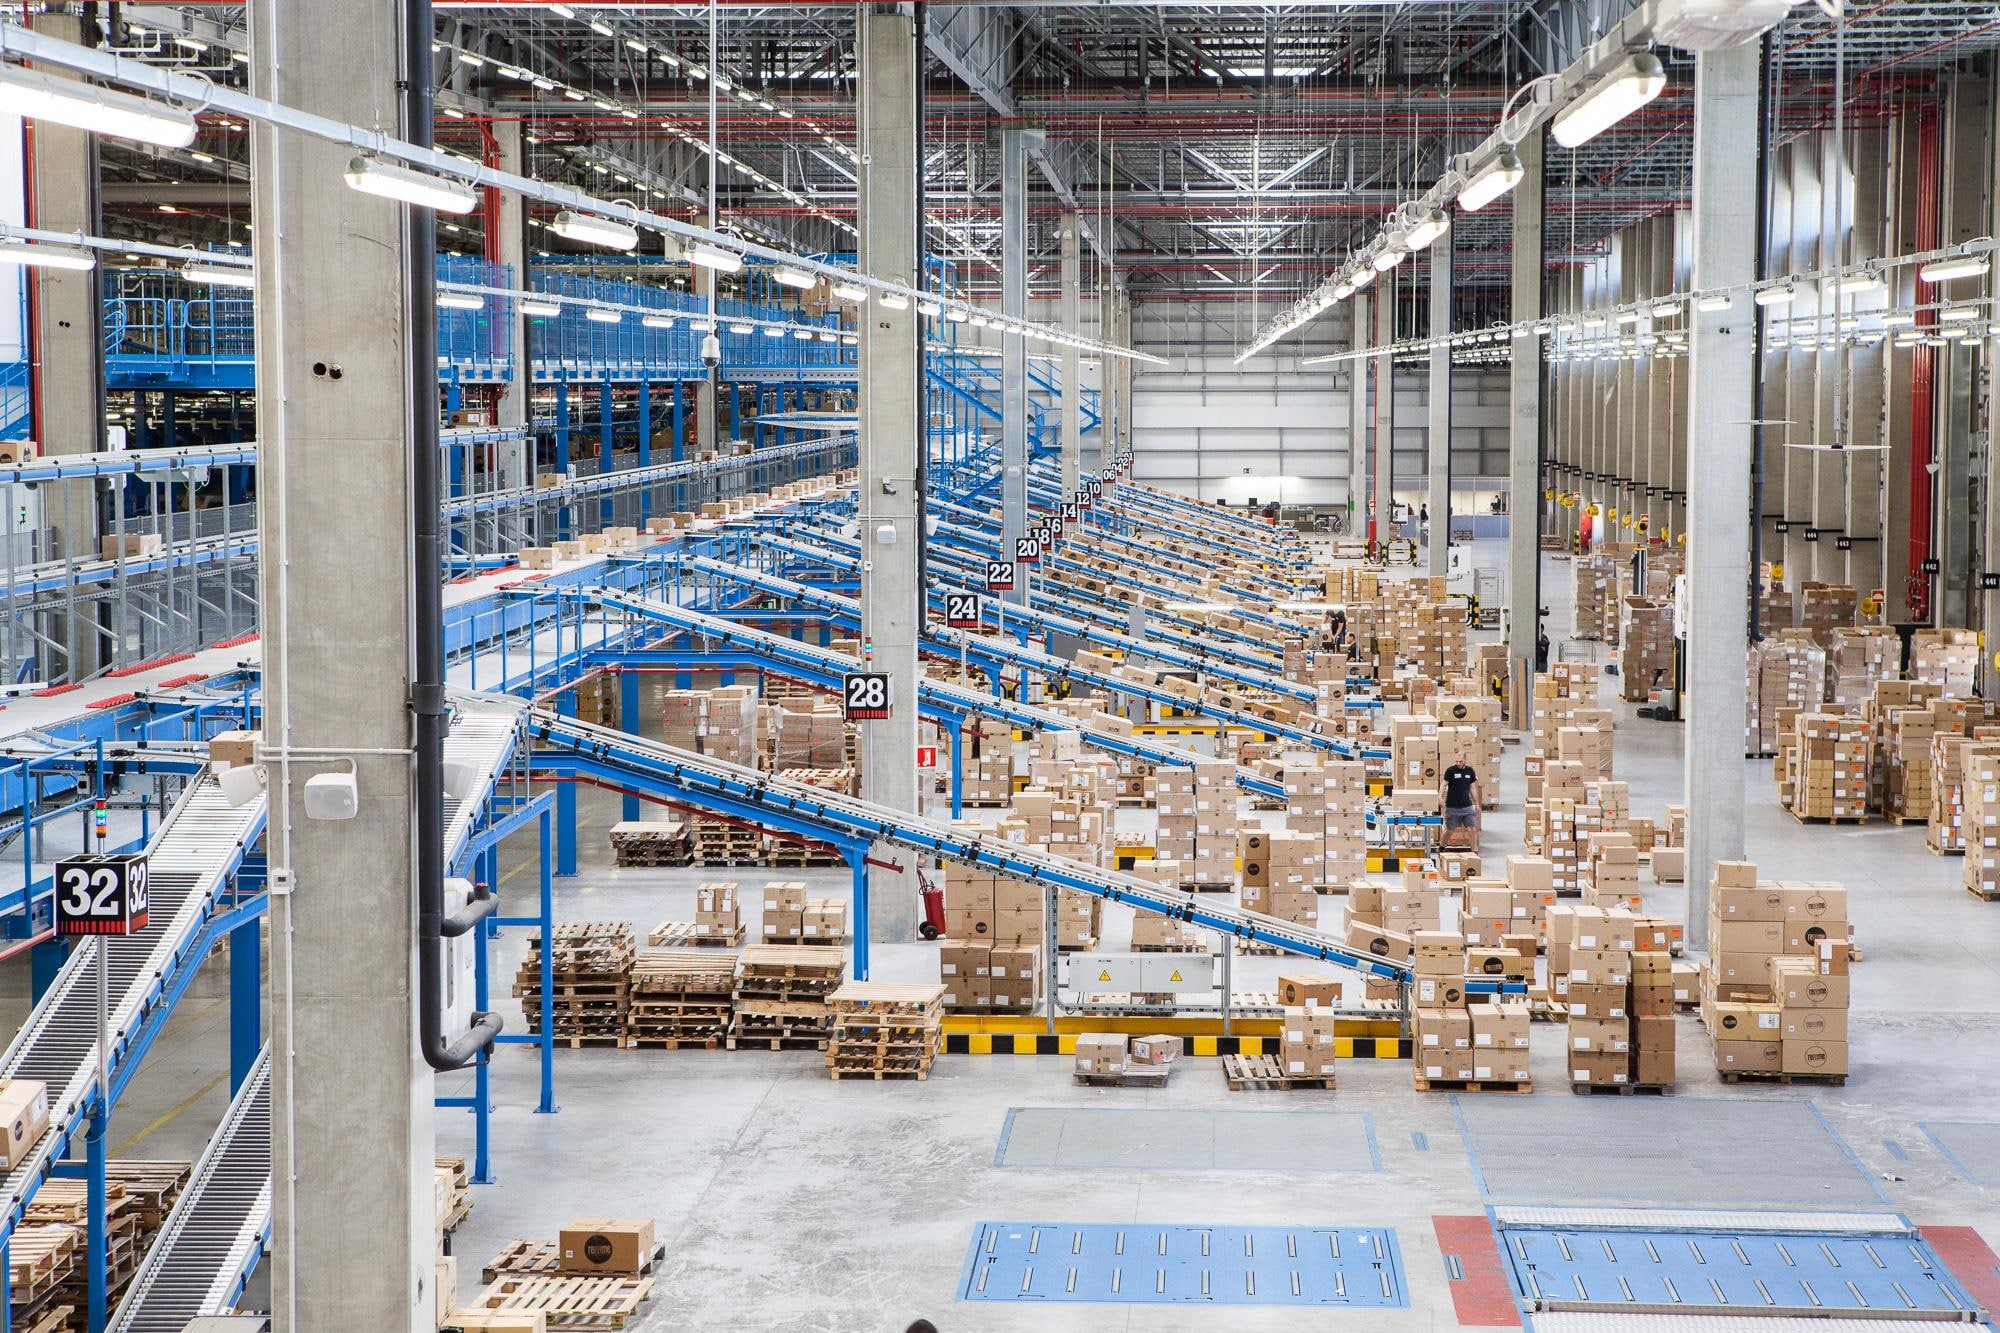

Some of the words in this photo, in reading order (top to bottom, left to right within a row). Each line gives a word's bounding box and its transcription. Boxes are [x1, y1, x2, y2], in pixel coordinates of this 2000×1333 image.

[1103, 471, 1115, 480] 06
[1088, 483, 1100, 494] 10
[1076, 493, 1090, 505] 12
[1062, 504, 1076, 517] 14
[1045, 518, 1061, 533] 16
[1033, 528, 1050, 545] 18
[1017, 540, 1038, 557] 20
[989, 563, 1012, 583] 22
[949, 596, 976, 619] 24
[849, 677, 885, 708] 28
[61, 867, 119, 916] 32
[129, 862, 147, 914] 32
